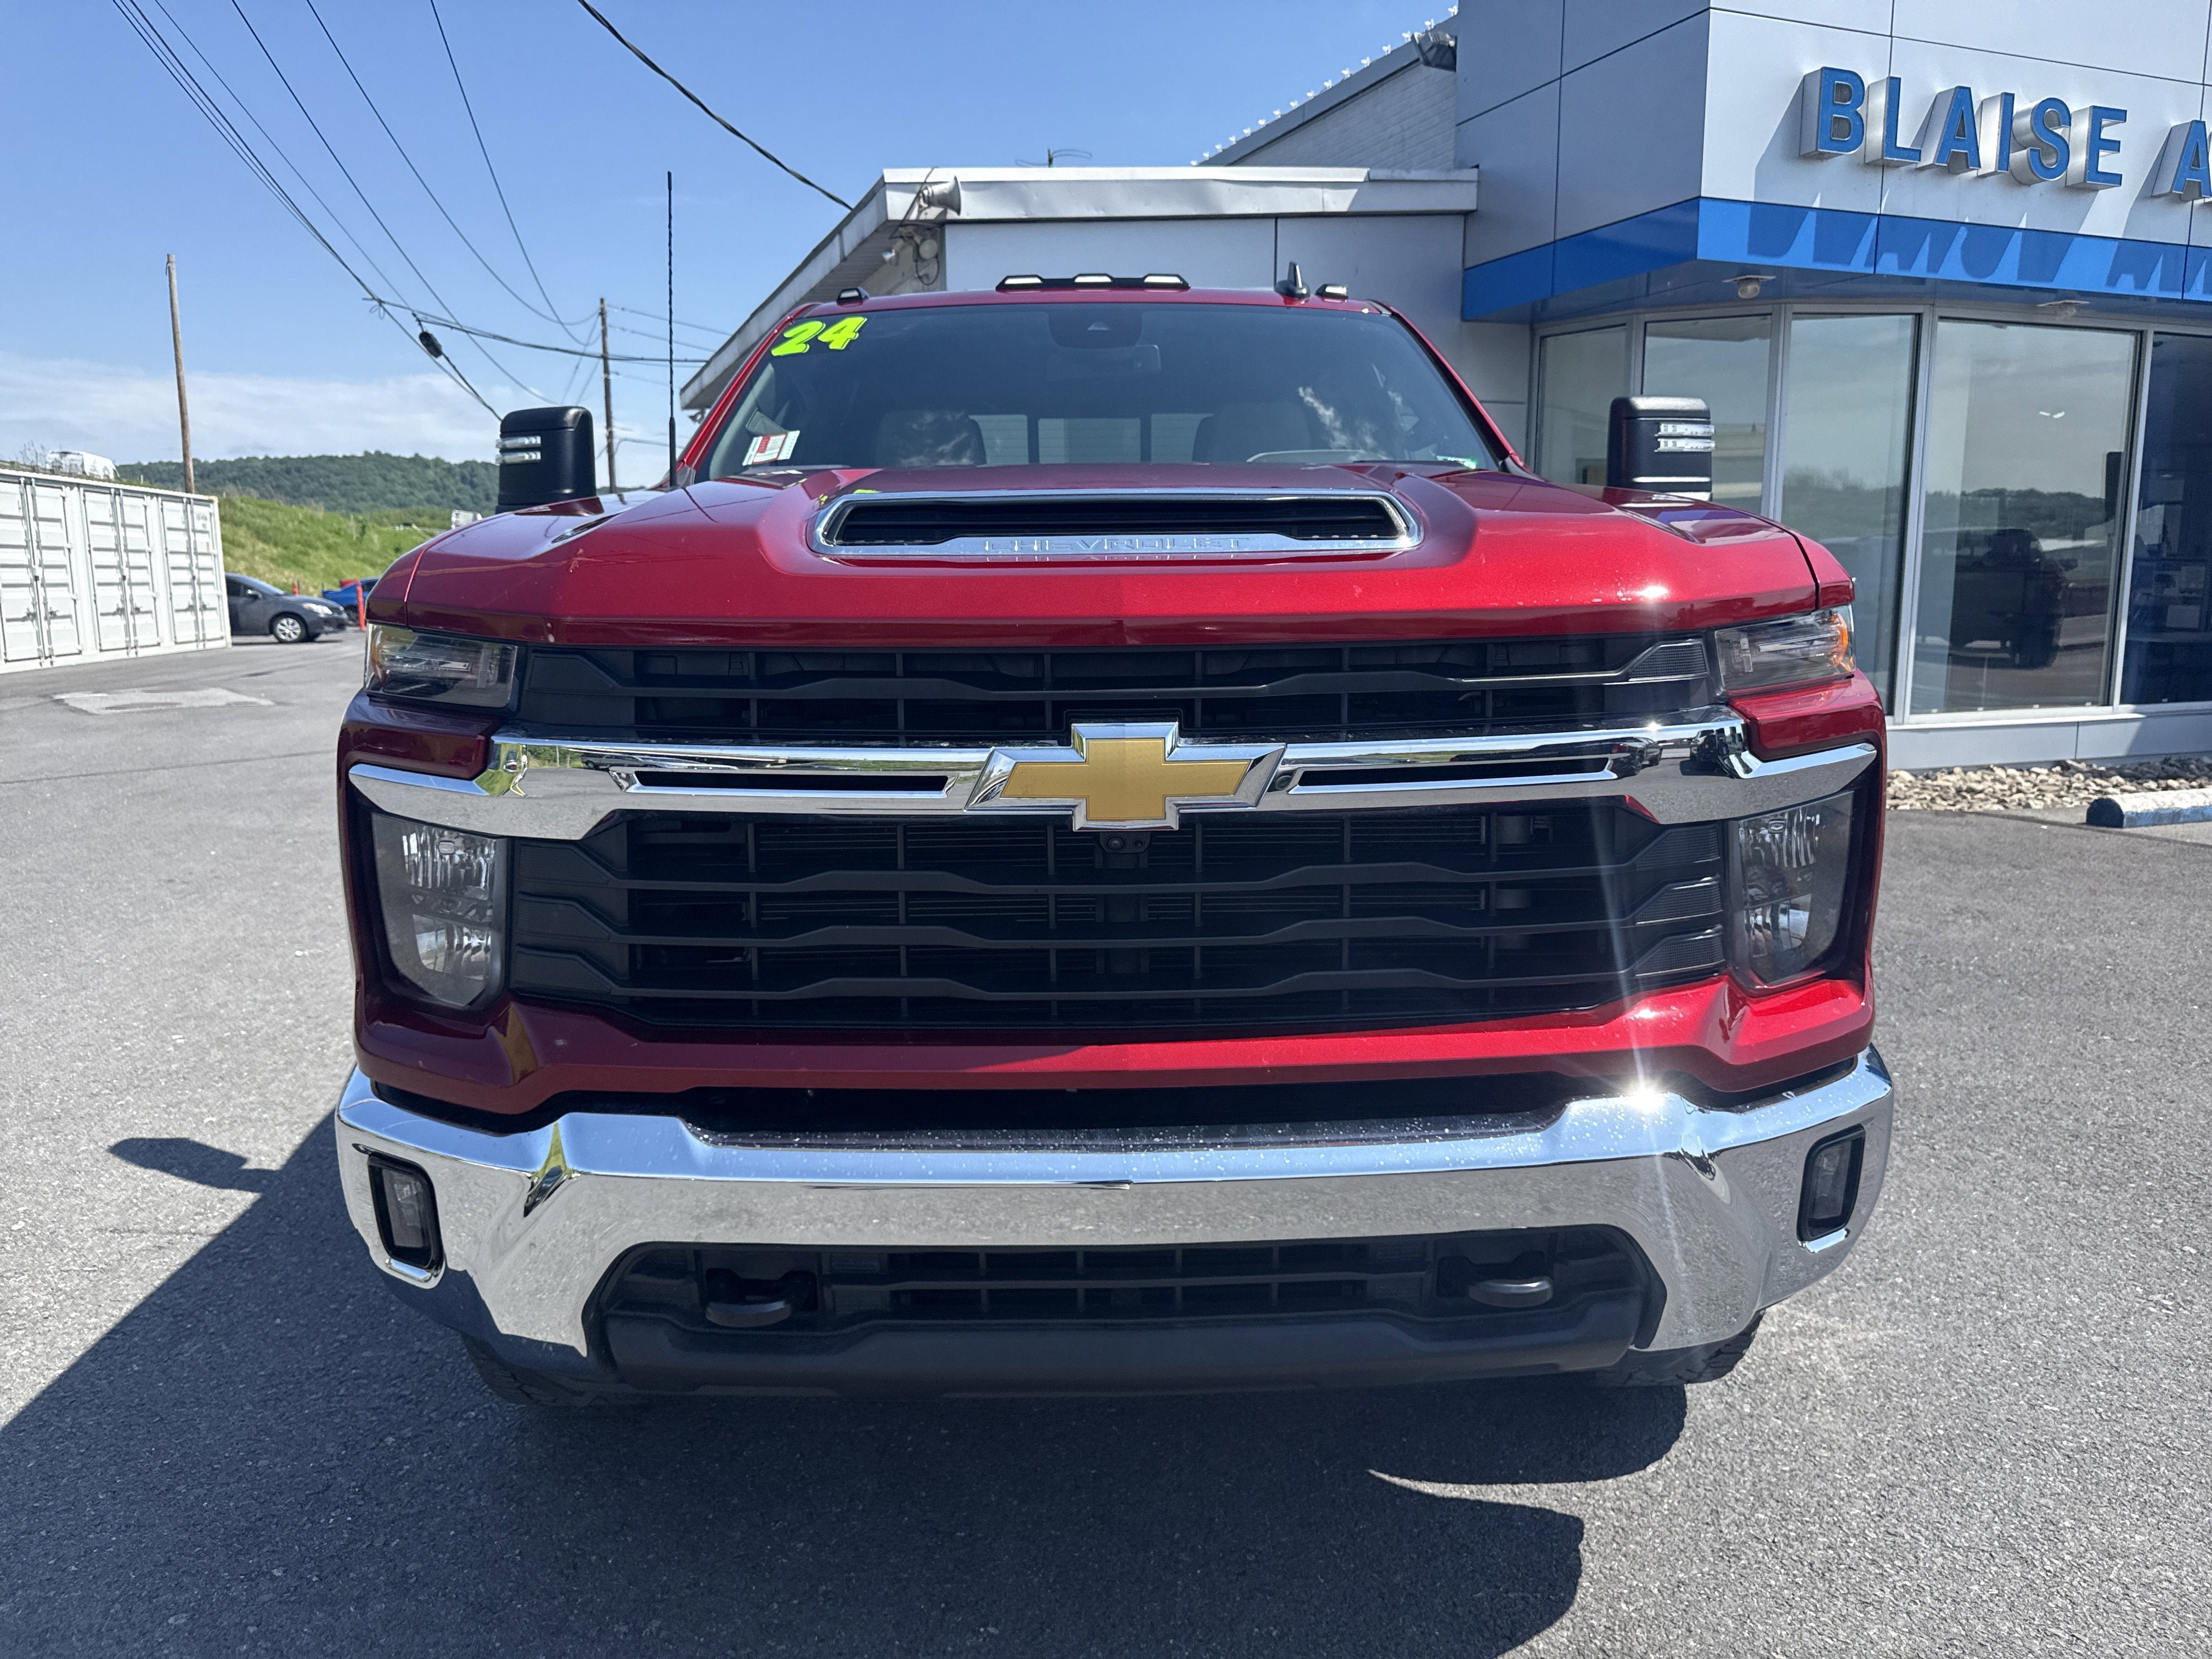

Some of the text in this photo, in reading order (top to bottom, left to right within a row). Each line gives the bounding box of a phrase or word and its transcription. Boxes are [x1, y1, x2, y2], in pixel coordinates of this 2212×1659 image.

[1817, 66, 2212, 198] BLAISE A
[771, 316, 868, 356] 24
[985, 537, 1249, 551] CHEVROLET
